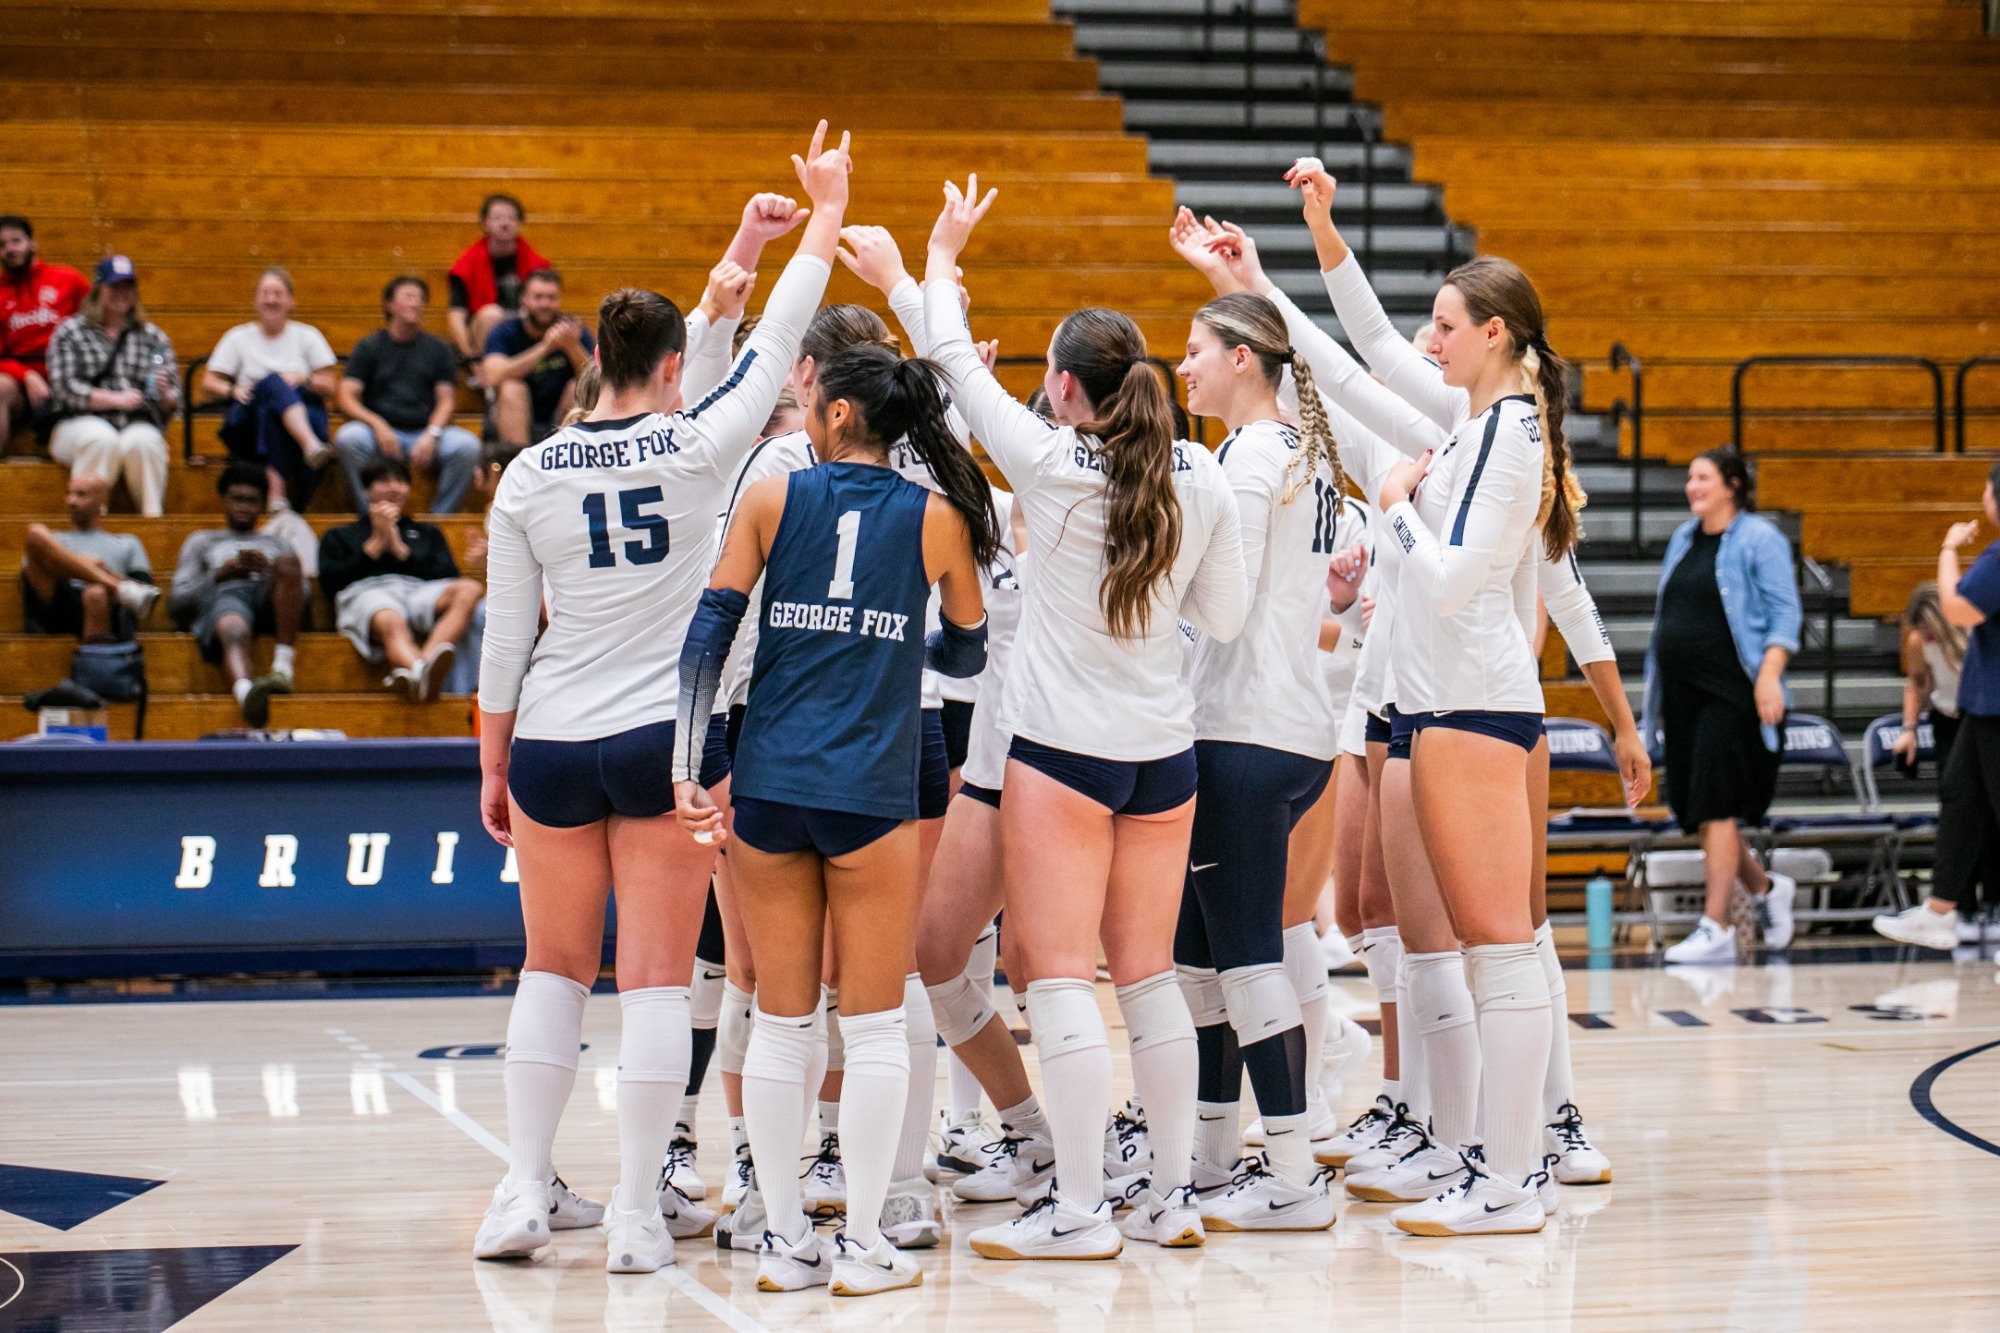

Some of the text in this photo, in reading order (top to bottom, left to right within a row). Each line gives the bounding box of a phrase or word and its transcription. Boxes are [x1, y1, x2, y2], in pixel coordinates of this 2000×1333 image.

[541, 428, 681, 471] GEORGE FOX
[582, 485, 671, 569] 15
[827, 510, 862, 600] 1
[769, 601, 909, 642] GEORGE FOX
[1547, 728, 1602, 754] UINS
[174, 831, 521, 889] BRUI
